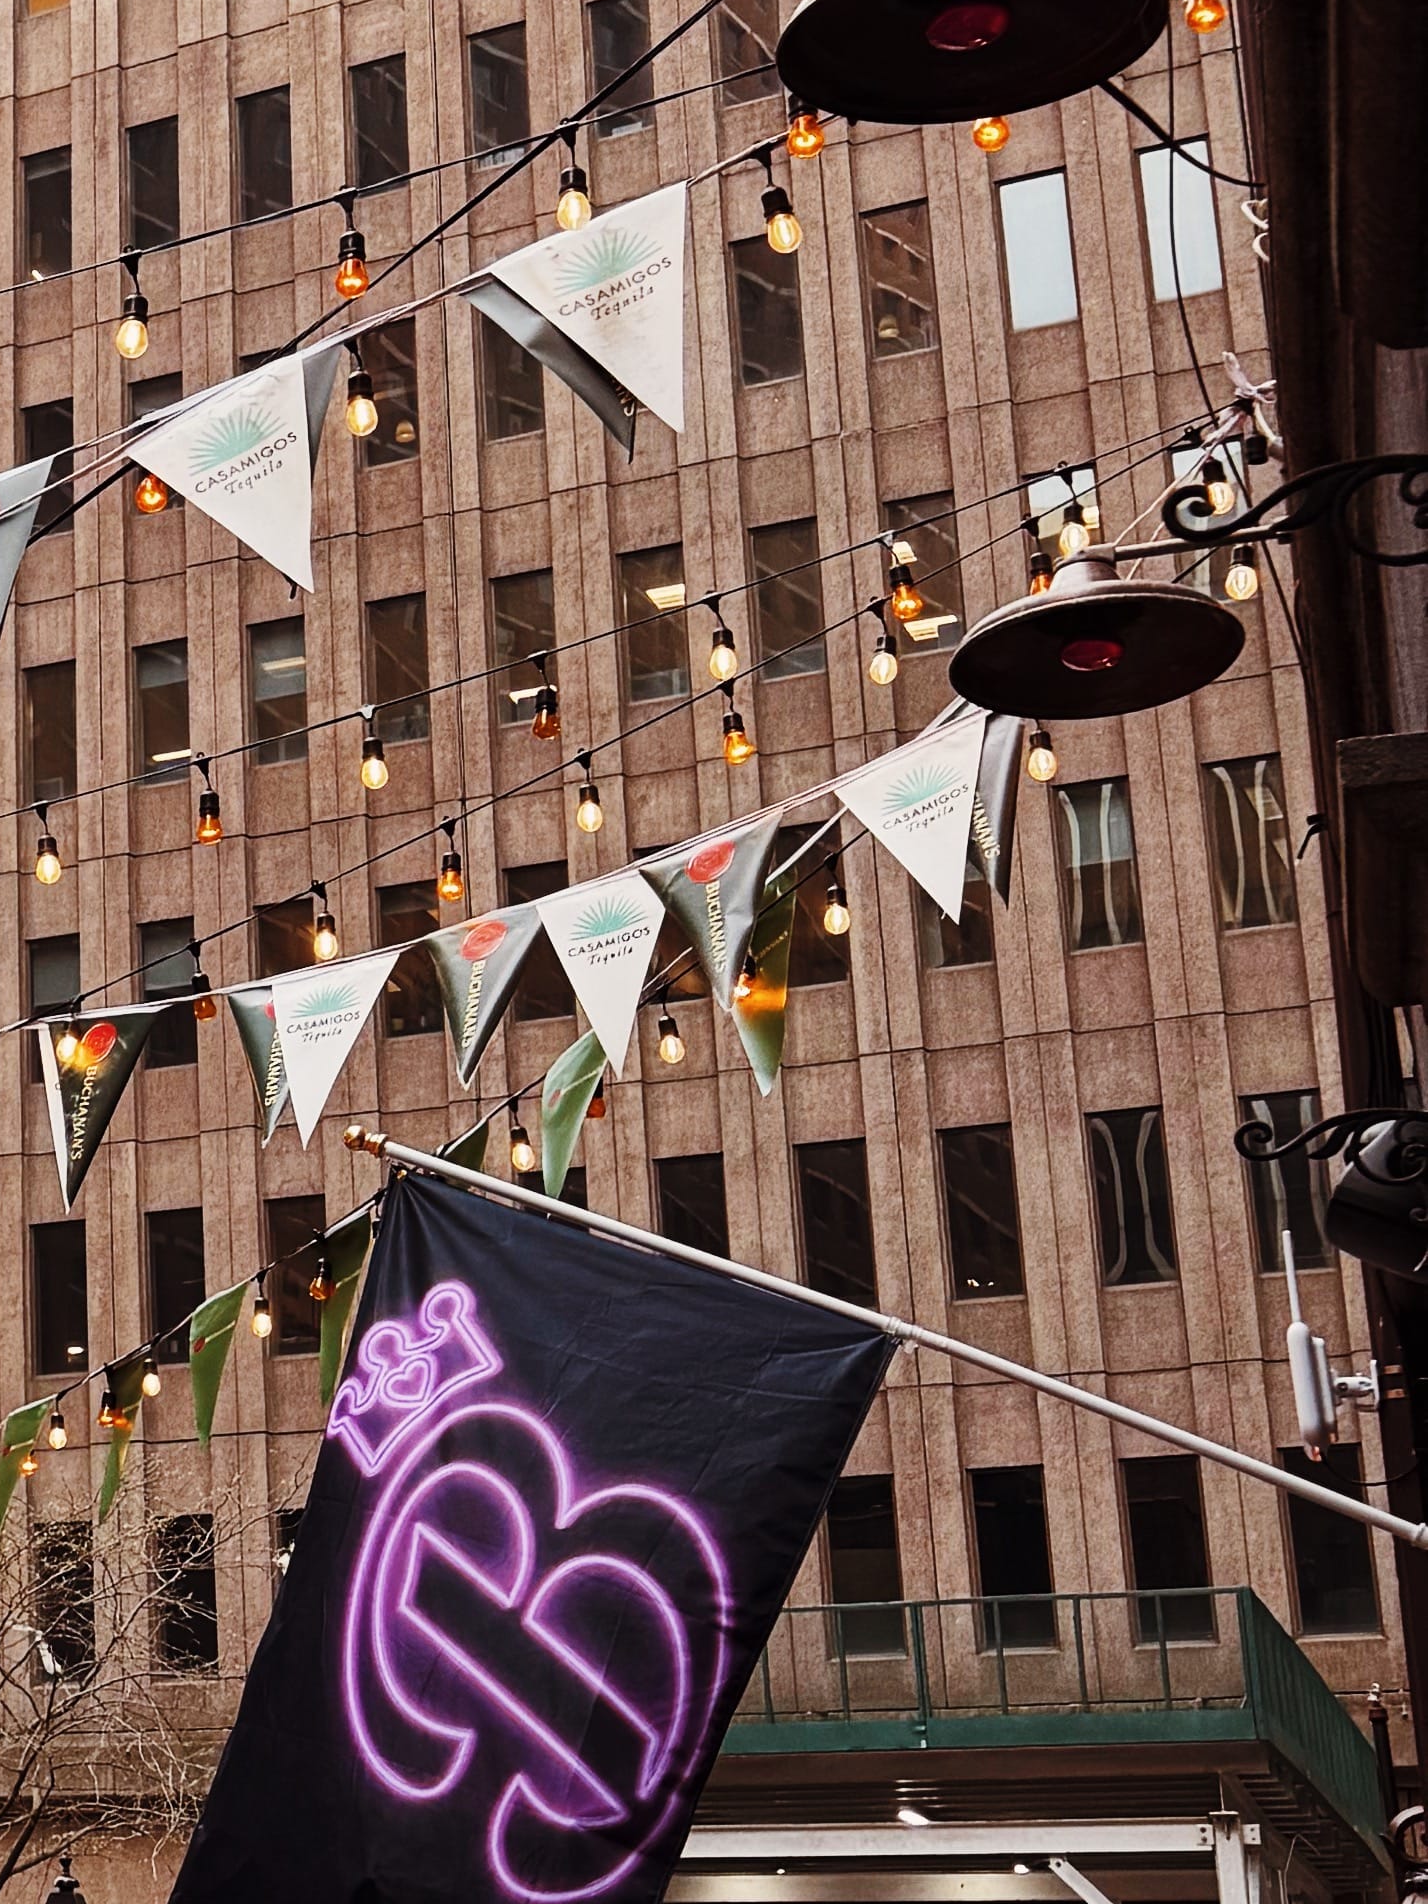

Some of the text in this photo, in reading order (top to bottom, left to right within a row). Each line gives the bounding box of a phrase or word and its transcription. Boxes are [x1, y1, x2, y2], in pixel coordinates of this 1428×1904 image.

[558, 255, 673, 318] CASAMIGOS
[194, 430, 299, 496] CASAMIGOS
[882, 781, 970, 833] CASAMIGOS
[567, 925, 651, 958] CASAMIGOS
[704, 881, 729, 975] BUCHANAN'S
[285, 1009, 362, 1035] CASAMIGOS
[461, 959, 486, 1049] BUCHANAN'S
